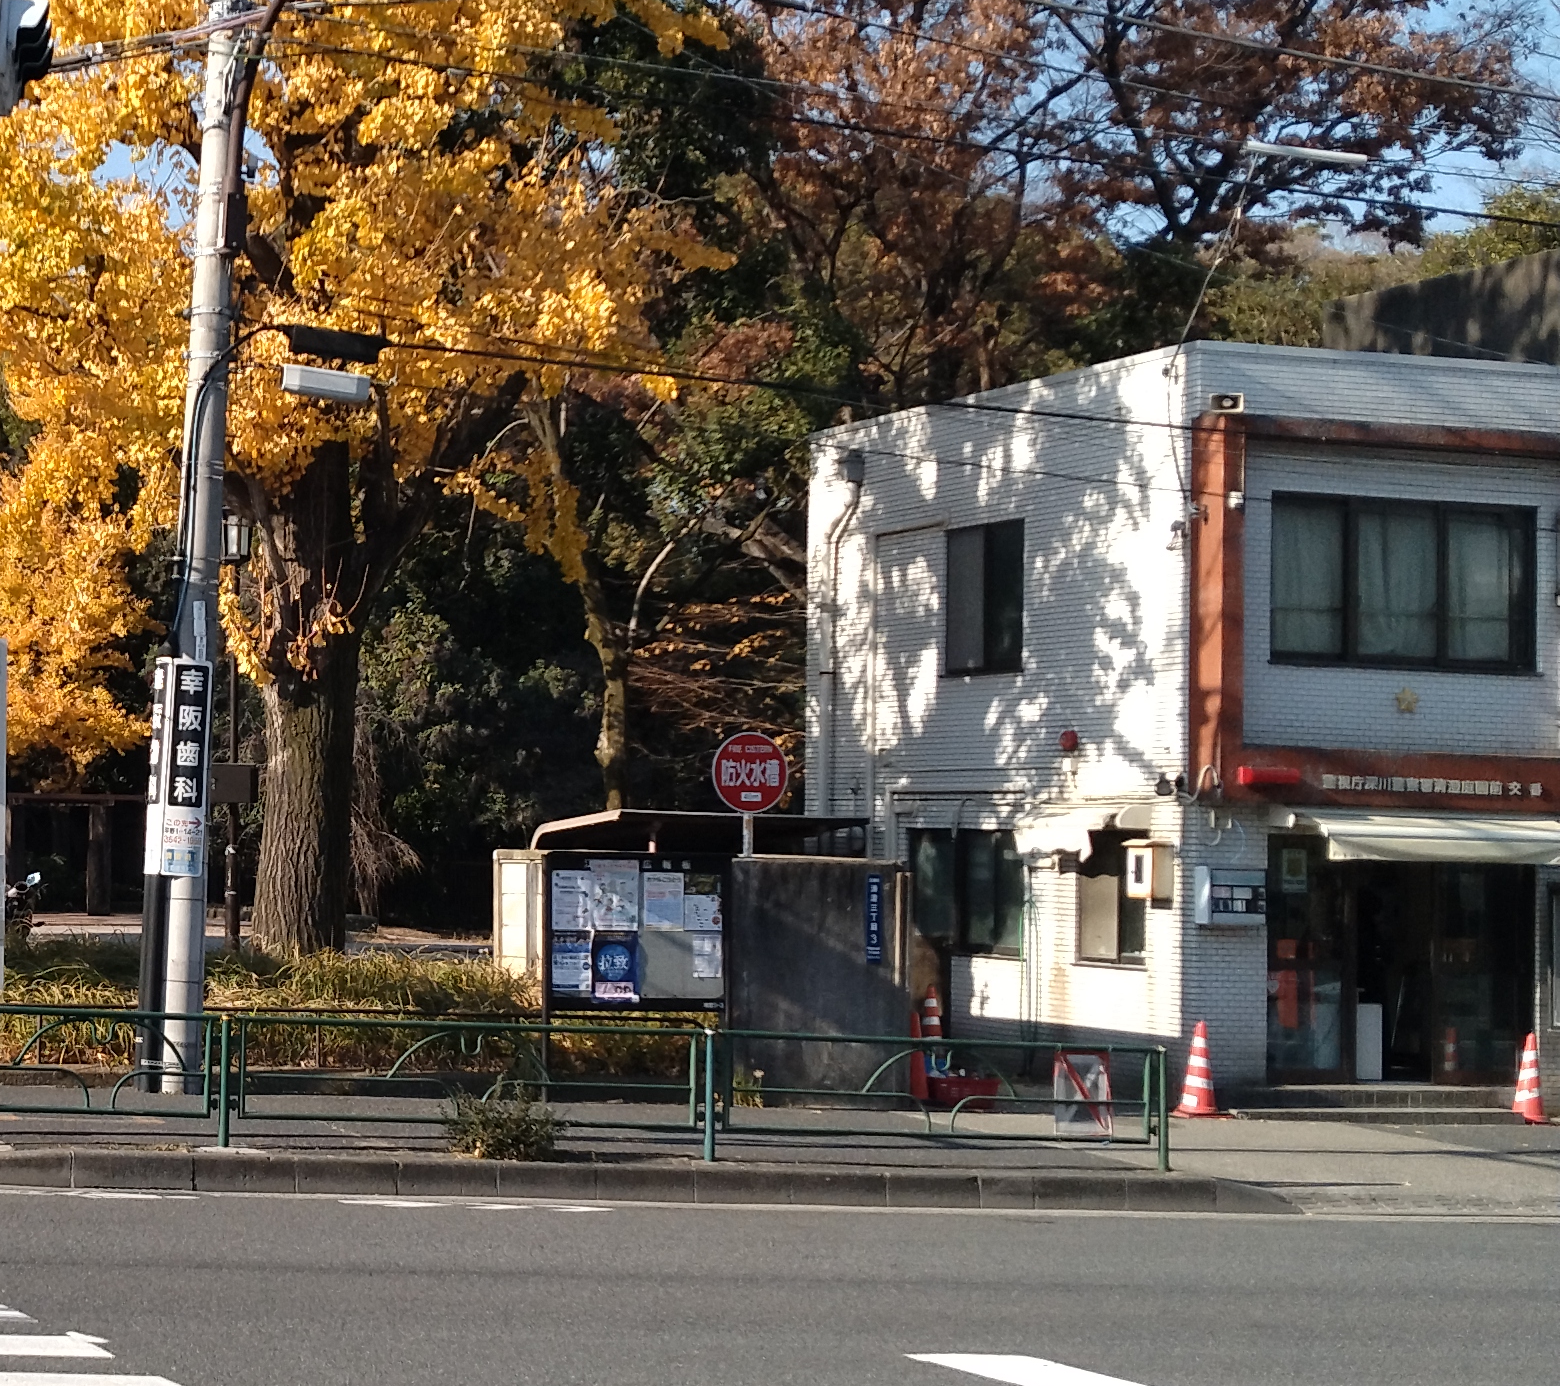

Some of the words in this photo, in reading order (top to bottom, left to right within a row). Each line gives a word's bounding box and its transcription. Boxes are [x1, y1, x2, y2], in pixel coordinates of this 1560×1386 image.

[173, 668, 205, 803] 幸阪歯科
[721, 758, 780, 787] 防火水槽
[166, 818, 189, 827] この先
[870, 933, 878, 944] 3
[598, 954, 629, 971] 拉致
